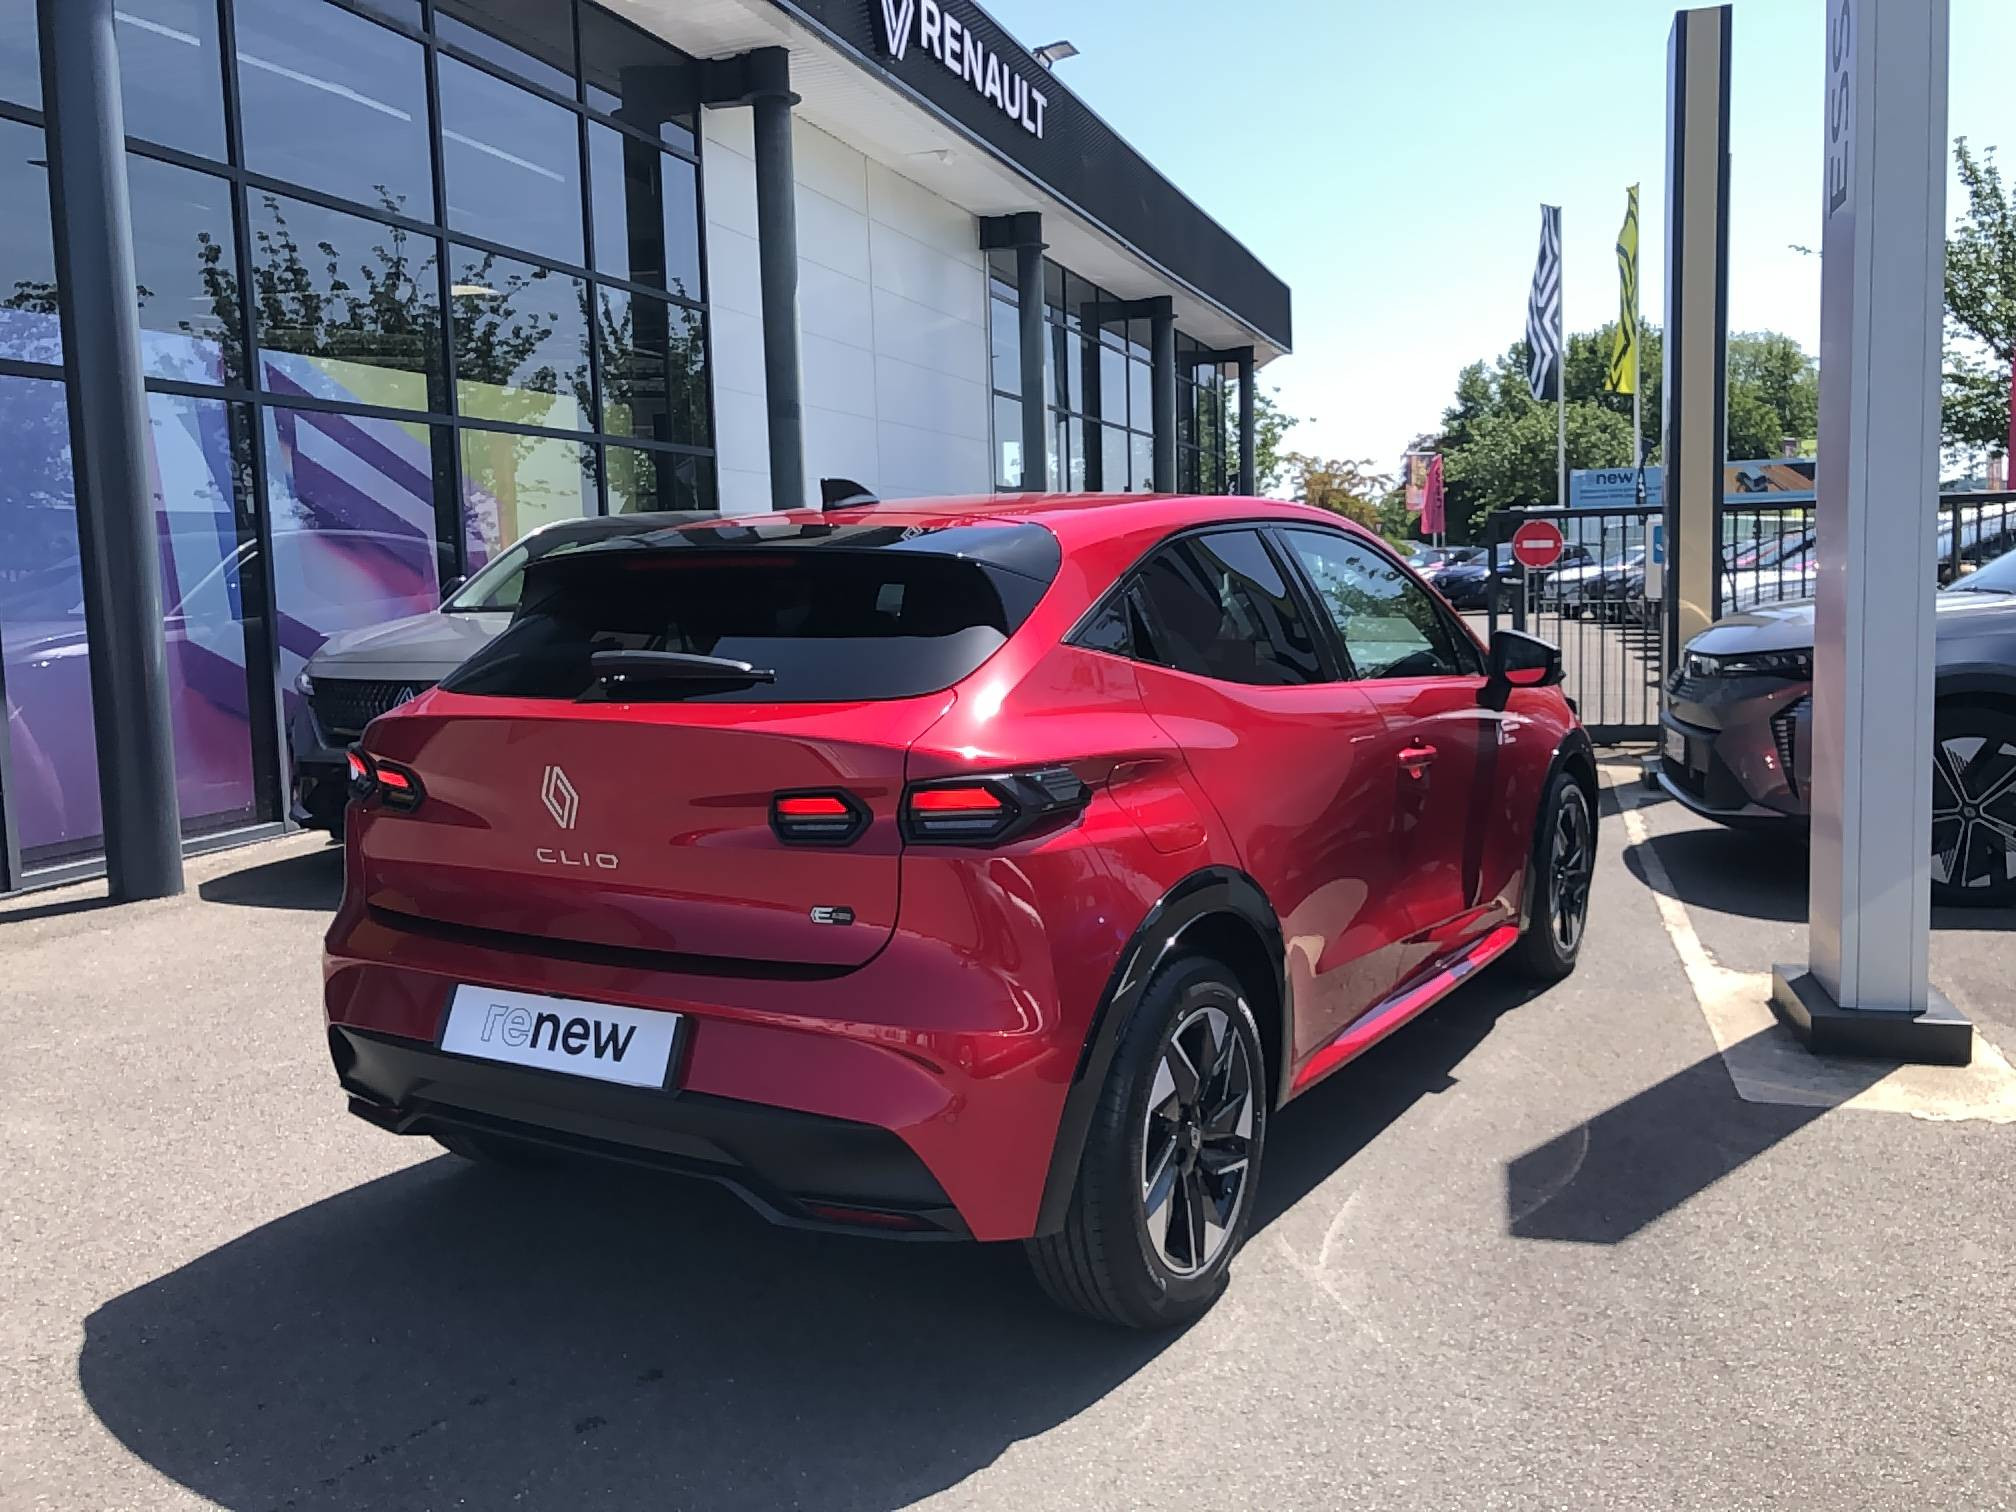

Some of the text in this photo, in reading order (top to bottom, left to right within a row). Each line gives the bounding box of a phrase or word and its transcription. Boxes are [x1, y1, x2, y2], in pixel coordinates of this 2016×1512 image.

[921, 0, 1048, 140] RENAULT
[536, 847, 619, 869] CLIO
[480, 1003, 638, 1063] renew
